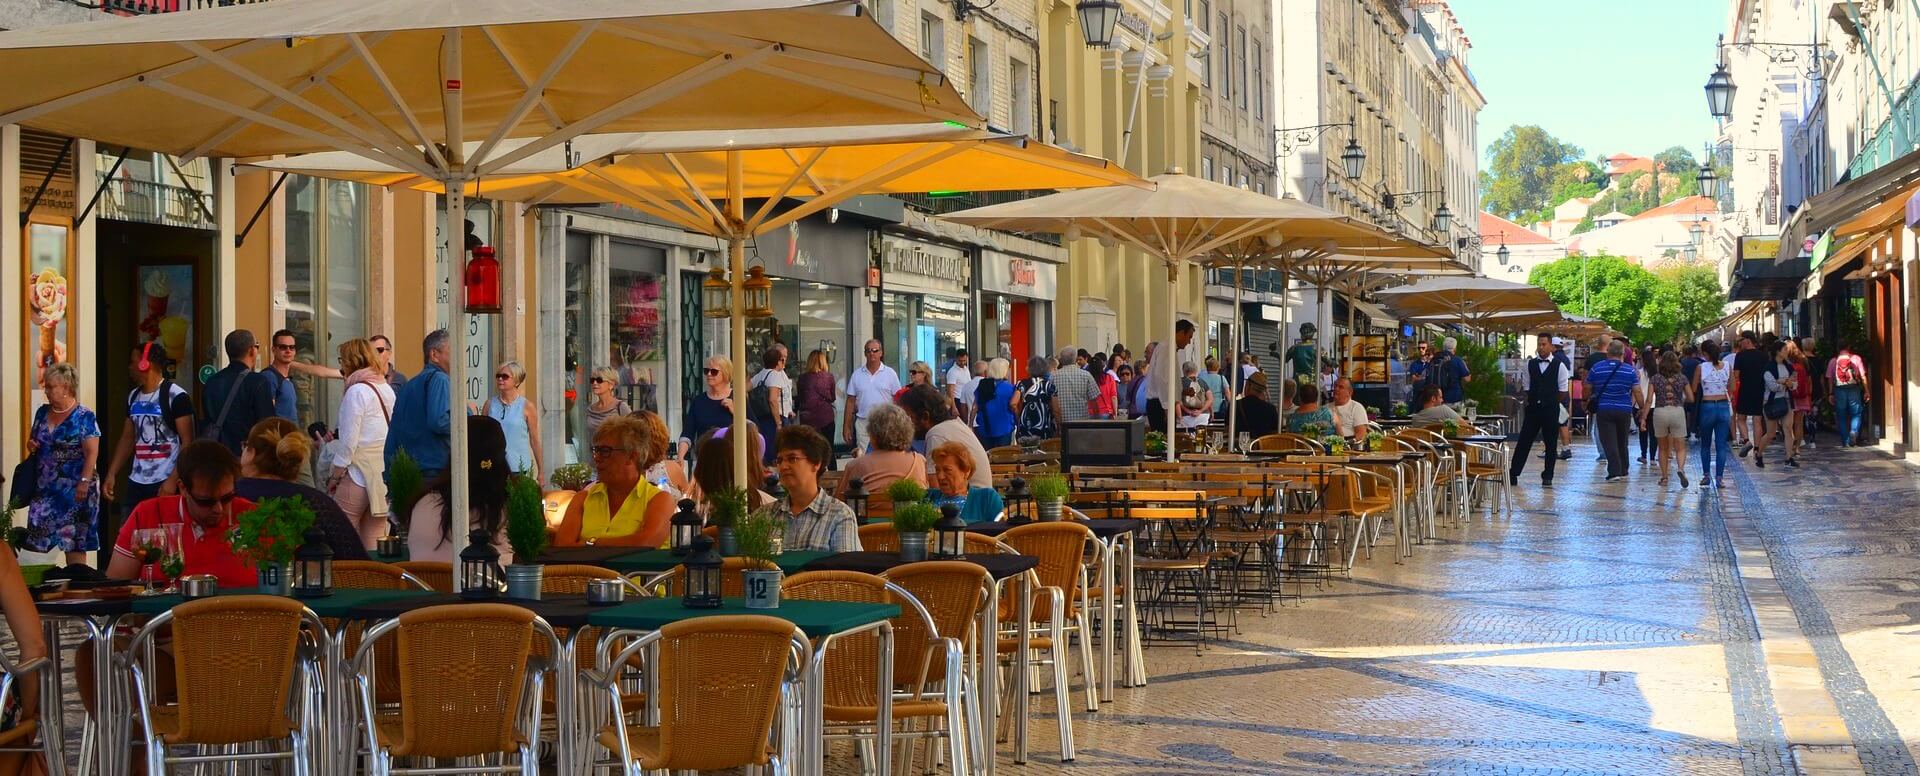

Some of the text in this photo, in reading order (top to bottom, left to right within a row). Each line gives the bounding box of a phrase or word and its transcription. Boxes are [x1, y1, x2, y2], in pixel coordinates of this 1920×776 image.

[935, 255, 962, 281] BARRAL
[261, 566, 278, 586] 10
[749, 578, 767, 599] 12
